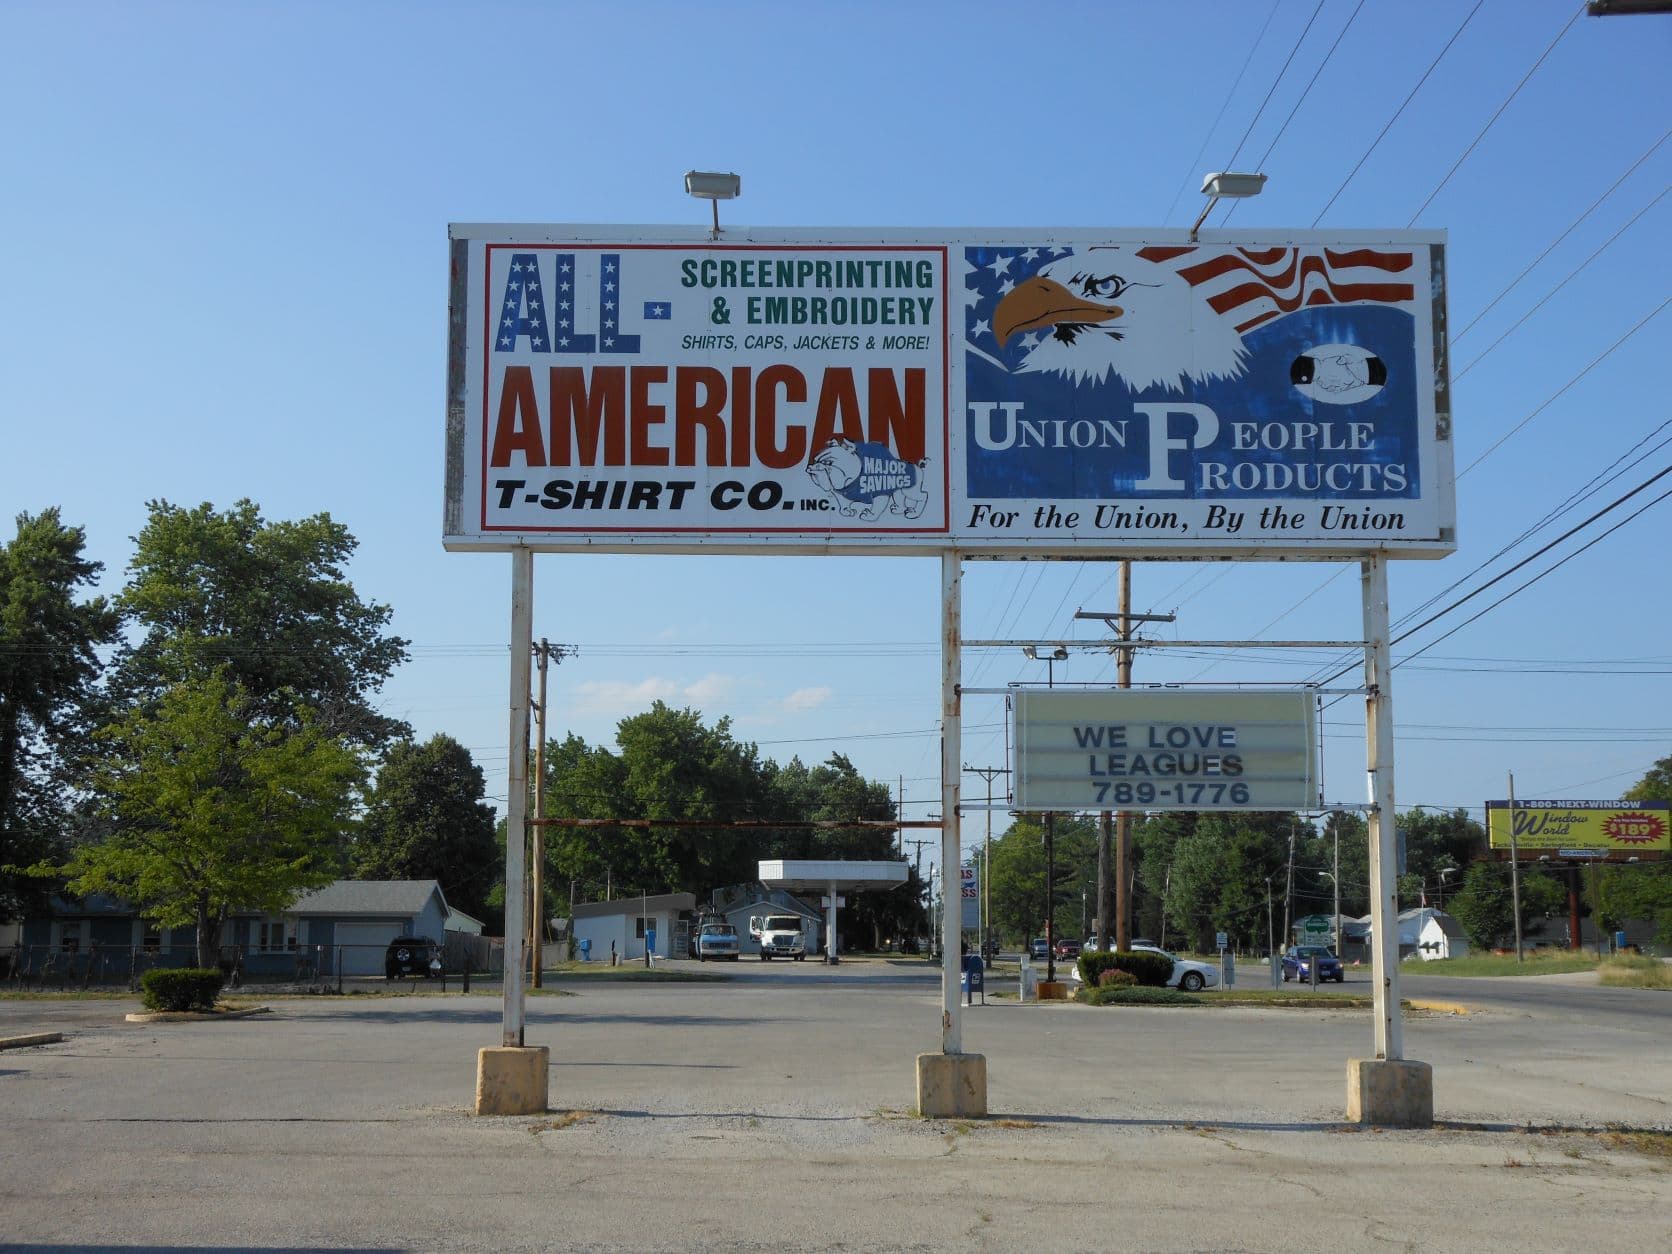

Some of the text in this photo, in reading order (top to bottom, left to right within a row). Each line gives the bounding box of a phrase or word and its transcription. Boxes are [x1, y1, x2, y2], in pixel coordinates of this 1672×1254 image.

[681, 259, 934, 289] SCREENPRINTING
[710, 296, 935, 326] & EMBROIDERY
[682, 335, 931, 352] SHIRTS, CAPS, JACKETS & MORE!
[490, 364, 927, 469] AMERICAN
[967, 401, 1129, 450] UNION
[863, 457, 907, 475] MAJOR
[494, 480, 836, 512] T-SHIRT CO. INC.
[859, 474, 912, 494] SAVINGS
[966, 504, 1406, 534] For the Union, By the Union
[1073, 726, 1237, 749] WE LOVE
[1089, 753, 1244, 777] LEAGUES
[1092, 781, 1250, 805] 789-1776
[1518, 800, 1641, 809] 1-800-NEXT-WINDOW
